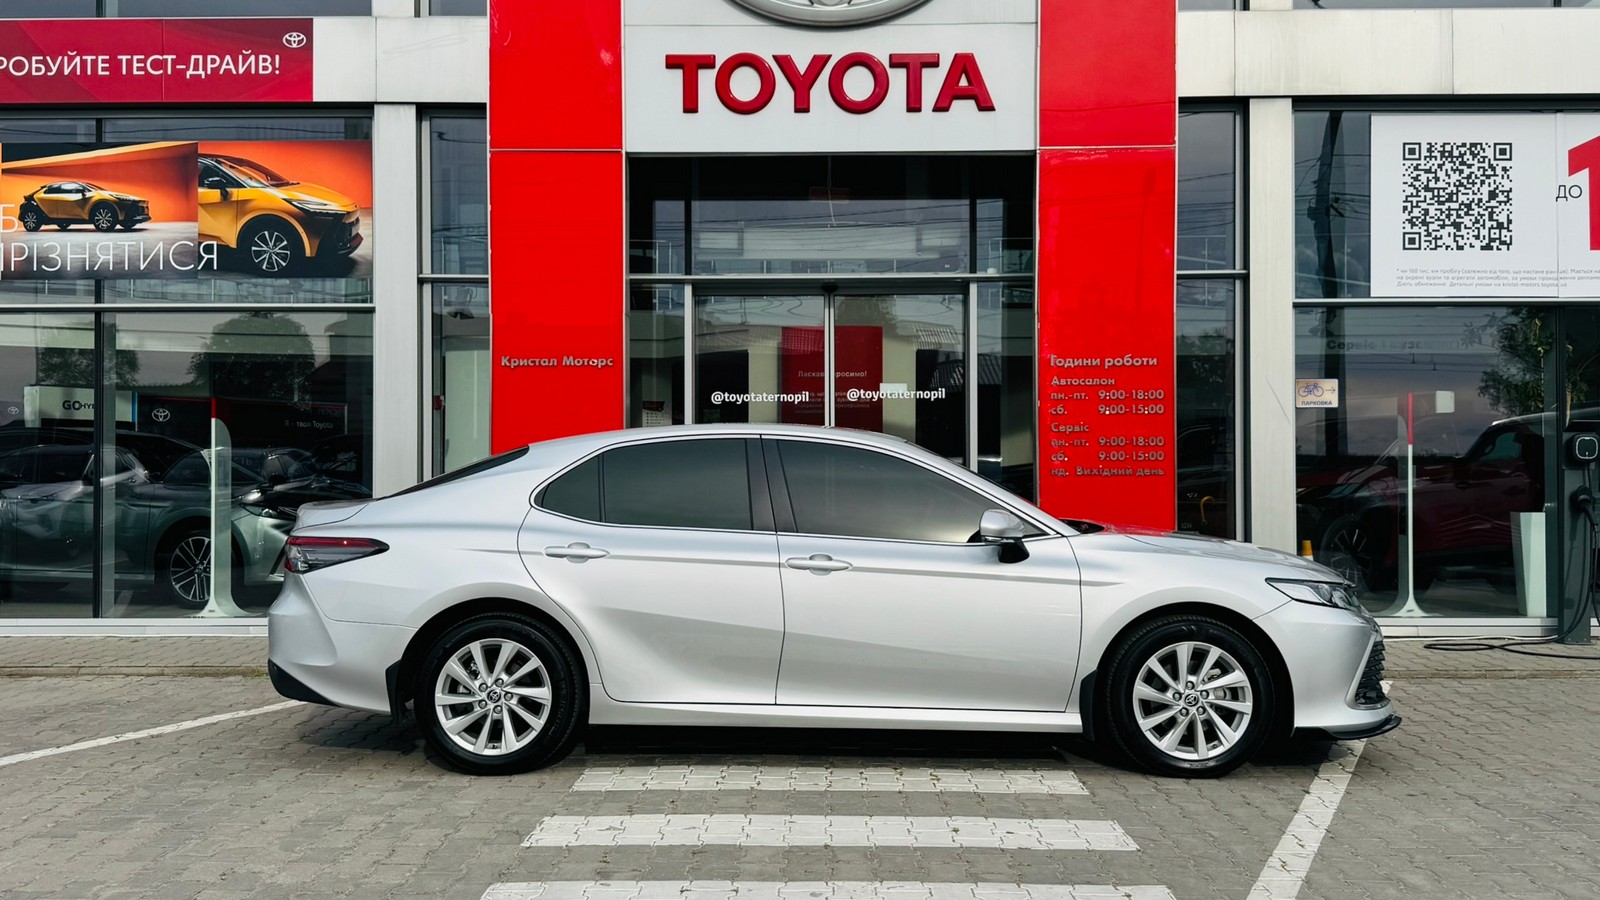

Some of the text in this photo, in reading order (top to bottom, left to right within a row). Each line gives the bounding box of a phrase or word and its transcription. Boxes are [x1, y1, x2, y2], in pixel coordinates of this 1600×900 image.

[118, 50, 281, 79] ТЕСТ-ДРАЙВ!
[665, 52, 996, 115] TOYOTA
[0, 240, 218, 271] РІЗНЯТИСЯ
[501, 355, 613, 368] Кристал Моторс
[1050, 353, 1158, 369] Години роботи
[835, 370, 867, 378] росимо!
[1051, 376, 1115, 386] Автосалон
[711, 391, 809, 405] @toyotaternopil
[846, 388, 946, 401] @toyotaternopil
[1051, 421, 1089, 434] Сервіс
[1076, 464, 1133, 477] Вихідний
[1136, 467, 1164, 477] день
